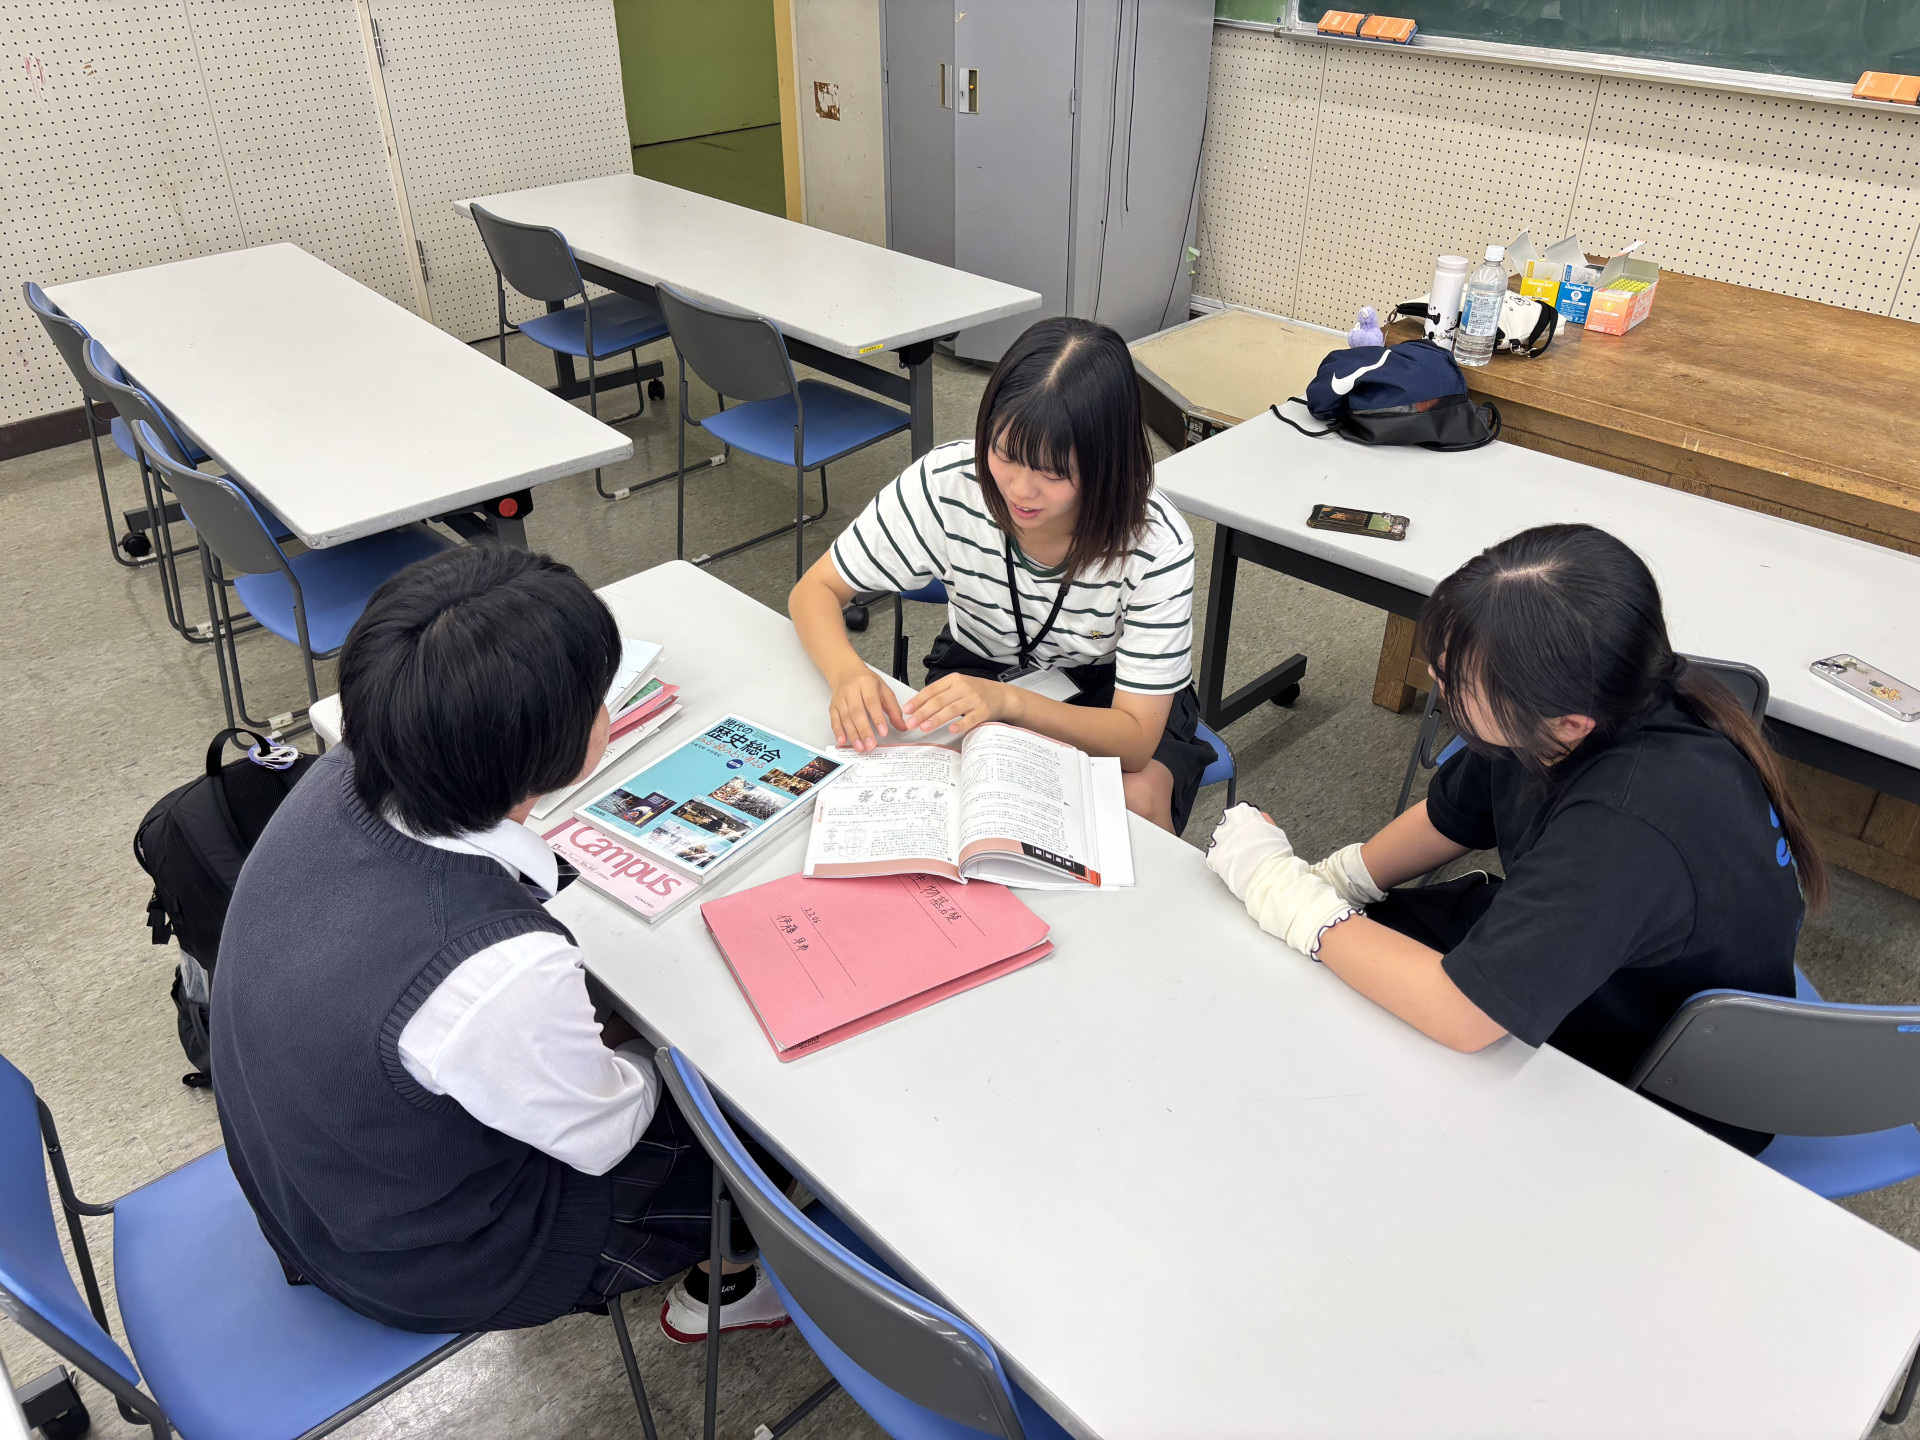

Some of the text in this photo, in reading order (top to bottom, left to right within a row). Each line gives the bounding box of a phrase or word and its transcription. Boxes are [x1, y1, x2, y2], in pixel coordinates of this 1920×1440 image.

[723, 718, 753, 734] 現代の
[705, 725, 781, 763] 歴史総合
[570, 826, 682, 896] Campus
[908, 873, 961, 924] 生物基礎
[777, 914, 798, 934] 伊藤
[721, 1284, 736, 1293] Lee
